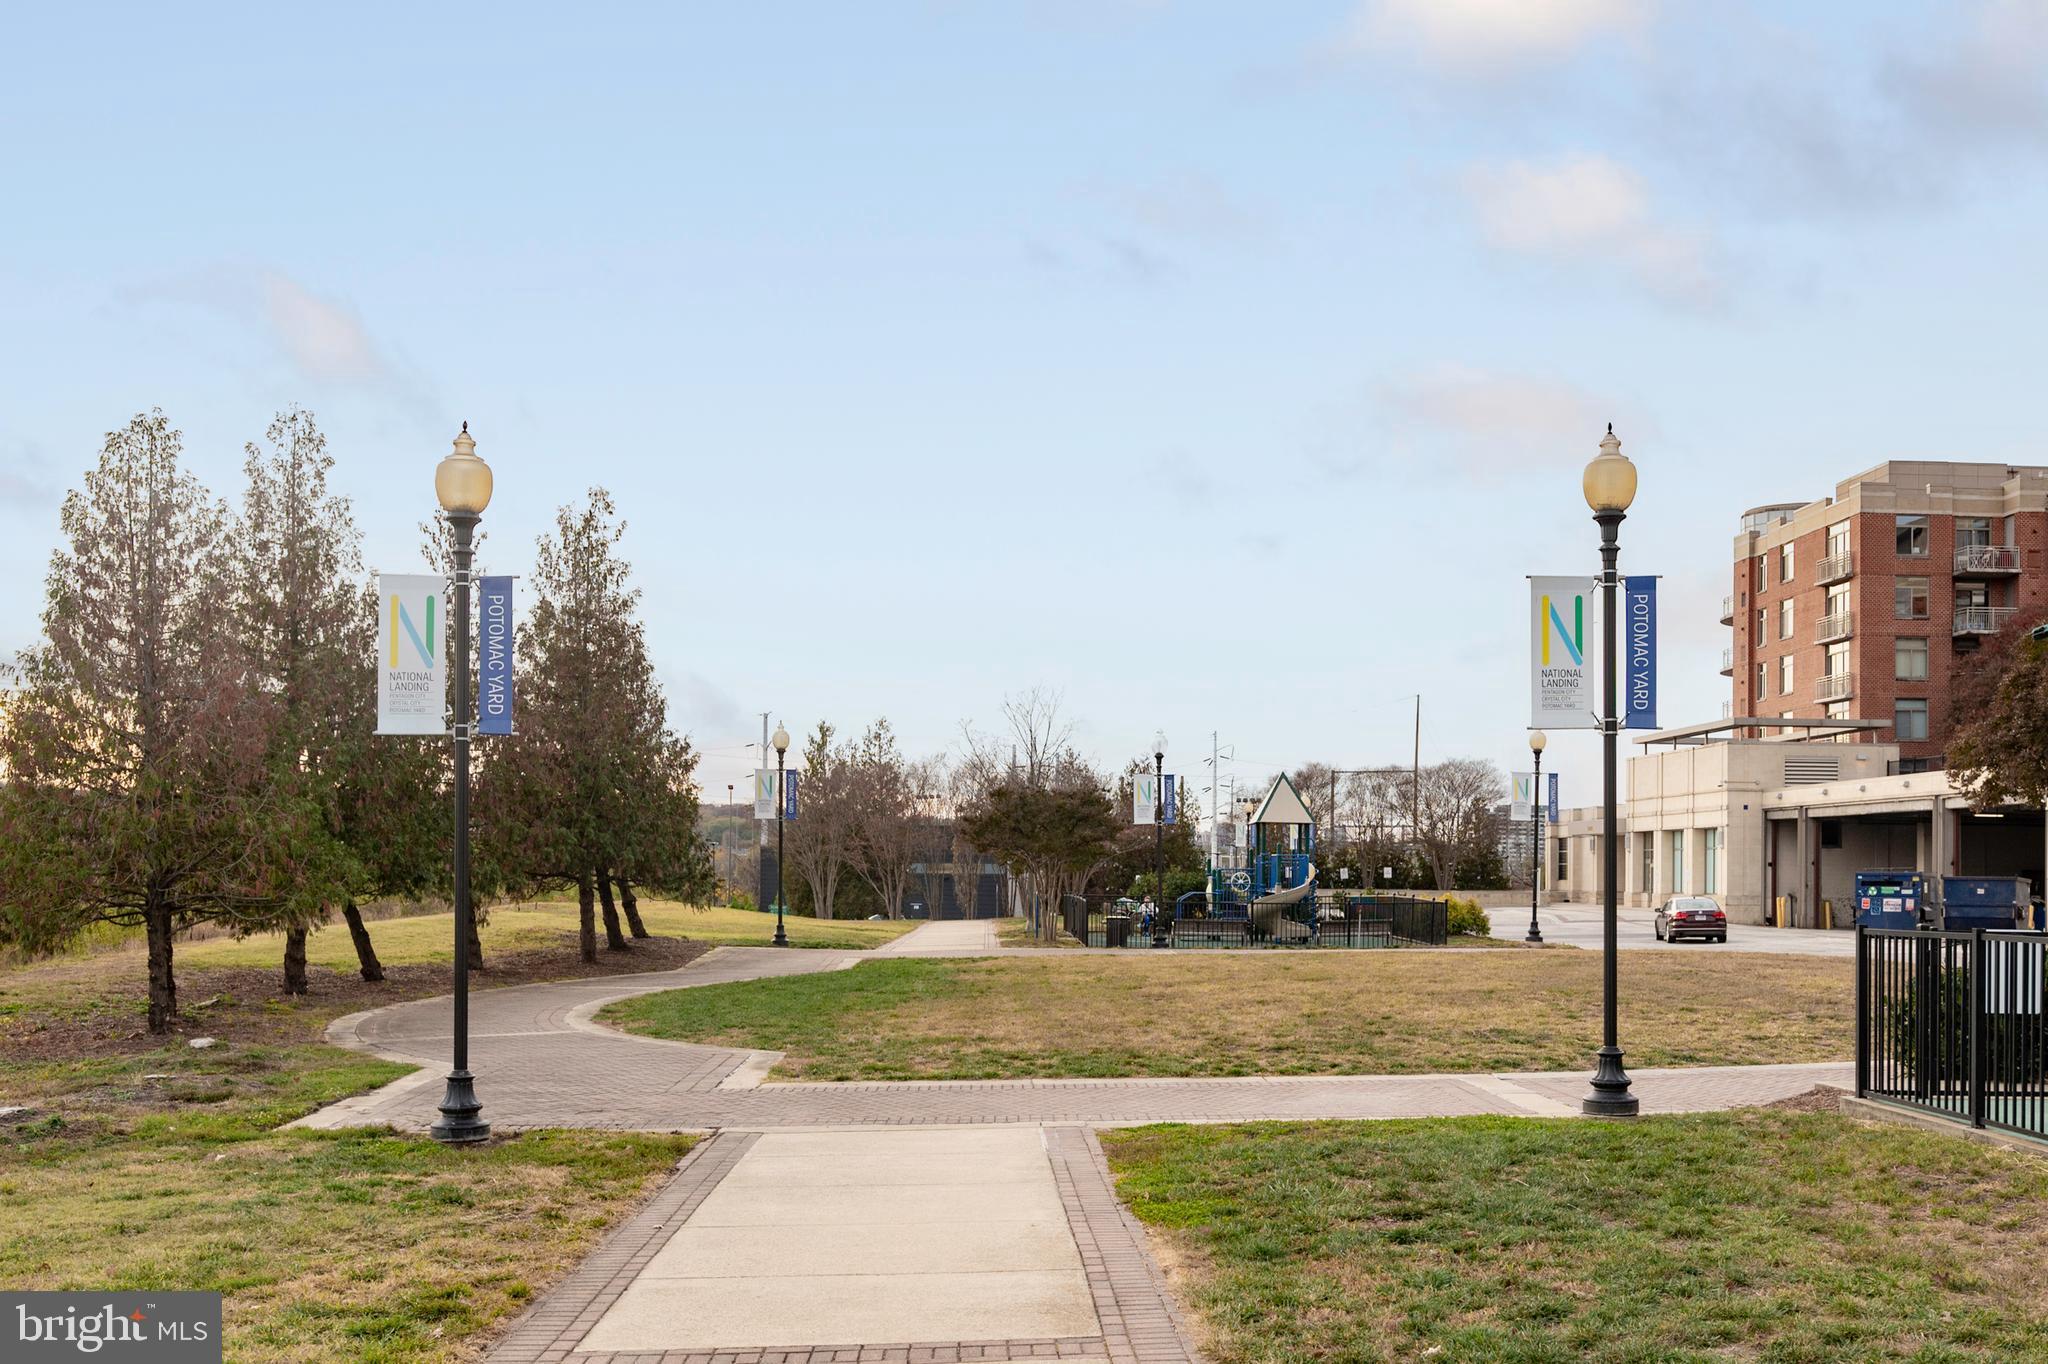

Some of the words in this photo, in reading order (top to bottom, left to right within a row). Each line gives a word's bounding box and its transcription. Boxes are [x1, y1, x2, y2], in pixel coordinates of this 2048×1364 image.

[488, 595, 504, 670] POTOMAC
[1634, 594, 1648, 667] POTOMAC
[389, 671, 435, 681] NATIONAL
[1541, 669, 1584, 678] NATIONAL
[1541, 678, 1579, 688] LANDING
[389, 682, 430, 691] LANDING
[488, 674, 504, 715] YARD
[1634, 671, 1648, 710] YARD
